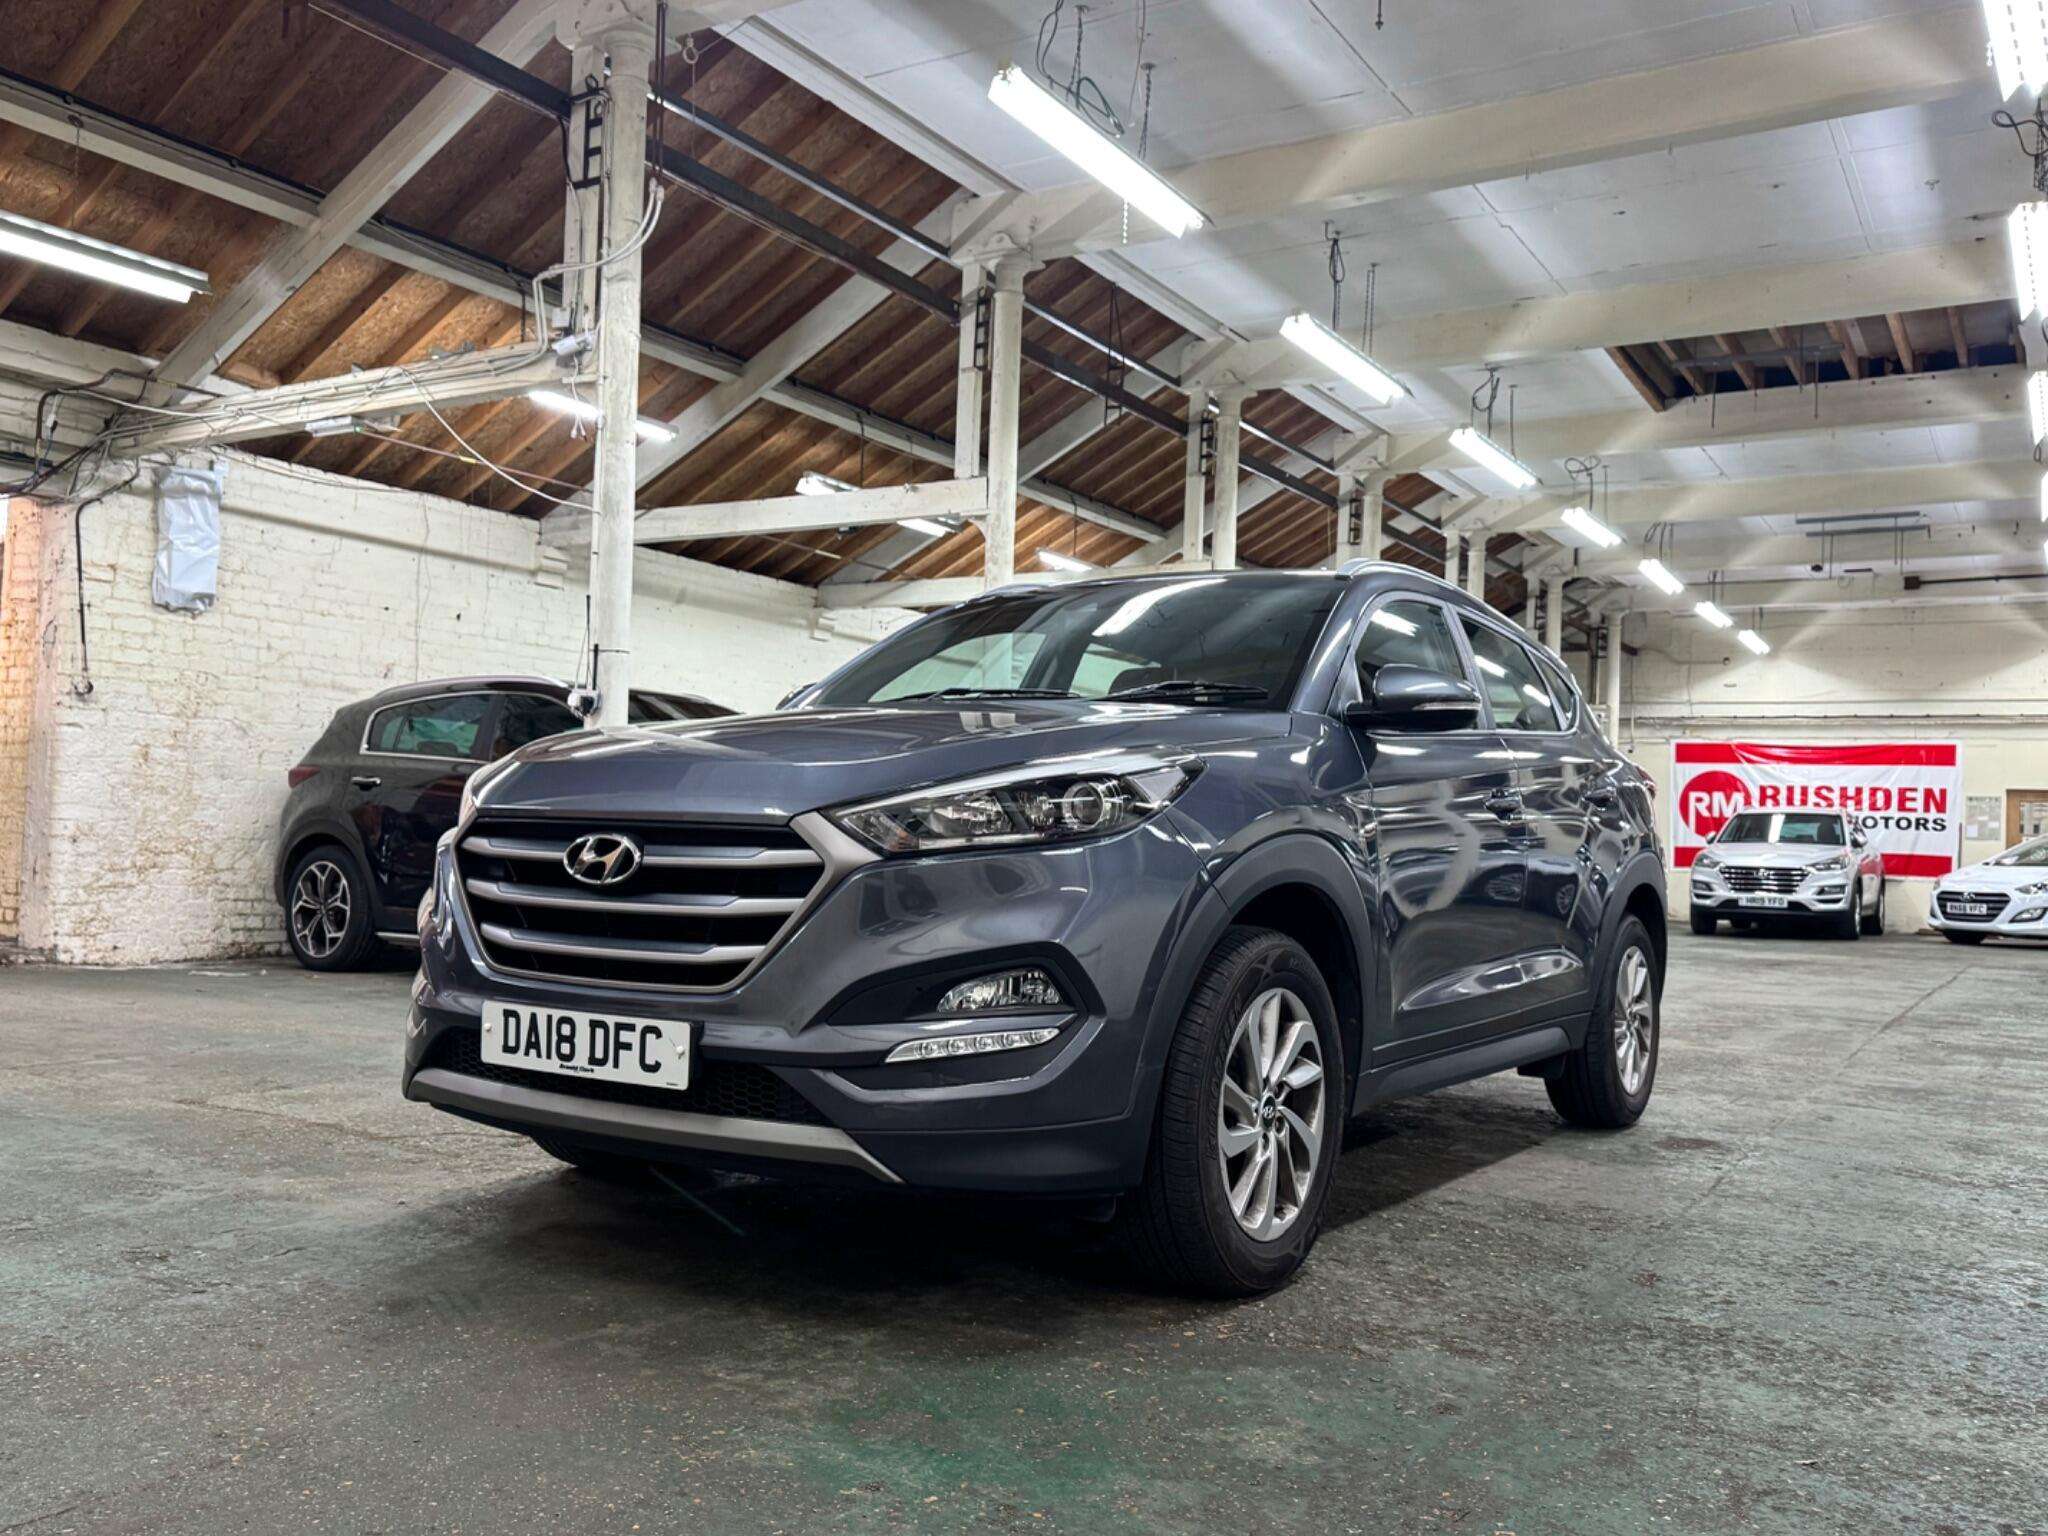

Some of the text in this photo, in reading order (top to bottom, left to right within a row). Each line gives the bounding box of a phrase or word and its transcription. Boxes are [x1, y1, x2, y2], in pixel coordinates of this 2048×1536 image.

[1689, 791, 1744, 829] RM
[1759, 785, 1947, 814] RUSHDEN
[502, 1008, 662, 1073] DA18 DFC
